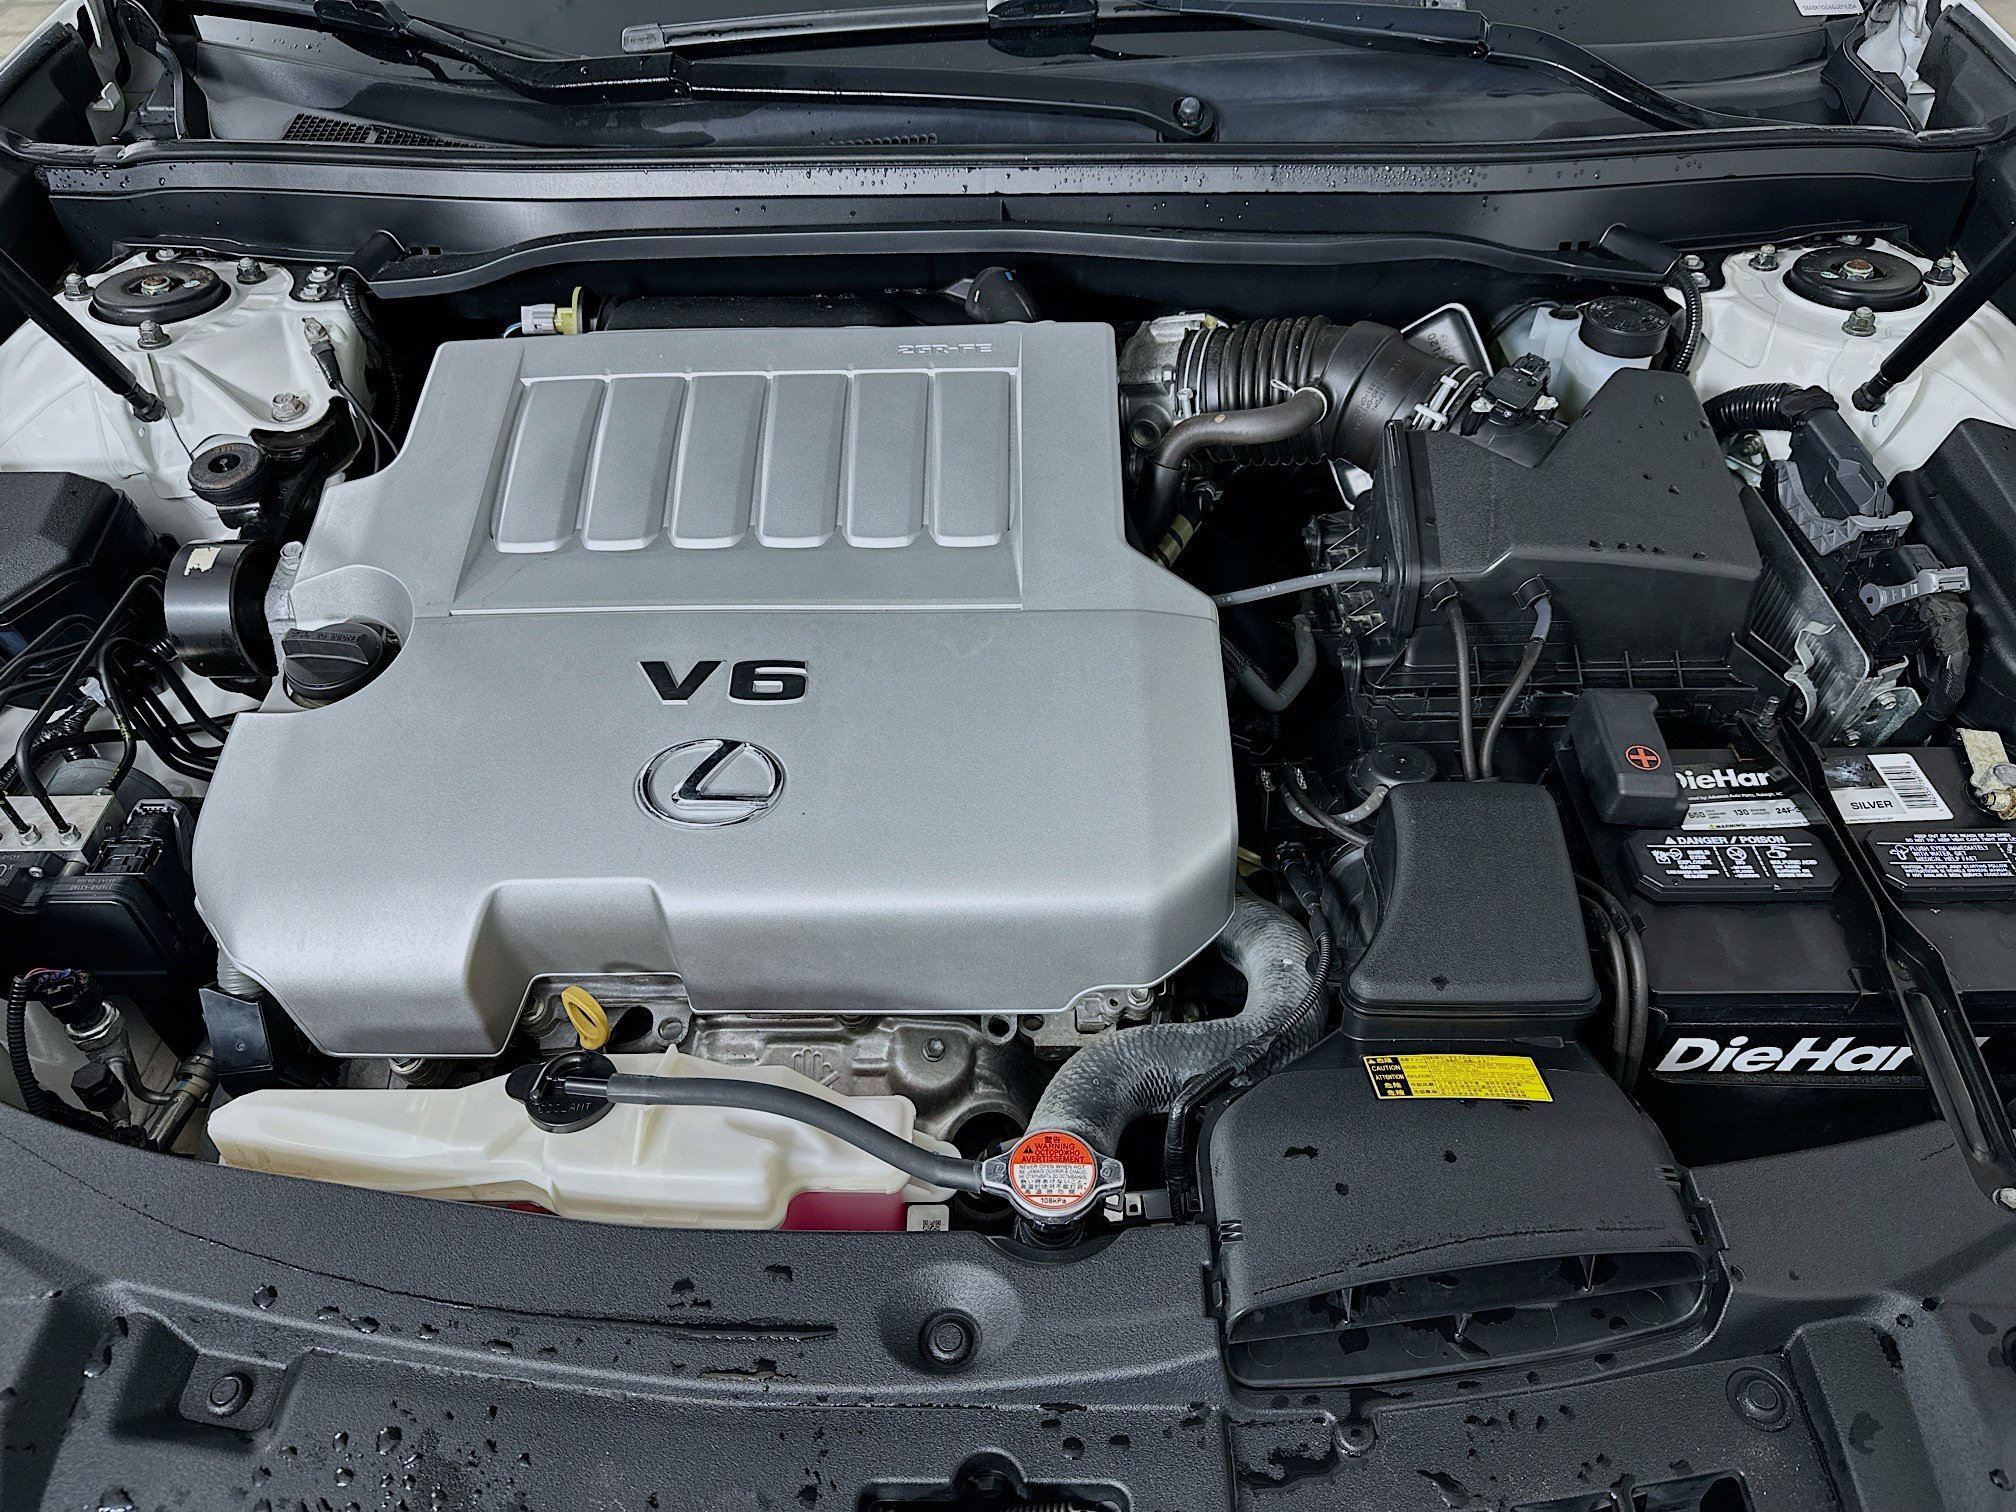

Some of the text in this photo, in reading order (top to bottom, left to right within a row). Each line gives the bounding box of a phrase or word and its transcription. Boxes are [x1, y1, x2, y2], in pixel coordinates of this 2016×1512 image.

[898, 343, 992, 354] 2GR-FE
[638, 660, 808, 705] V6
[1675, 768, 1773, 790] ieHar
[1850, 800, 1893, 810] SILVER
[1688, 811, 1706, 819] 650
[1733, 808, 1750, 816] 130
[1676, 835, 1787, 845] DANGER / POISON
[1655, 1036, 1990, 1072] DieHar
[1371, 1064, 1401, 1072] CAUTION
[1041, 1197, 1067, 1205] 108kPa
